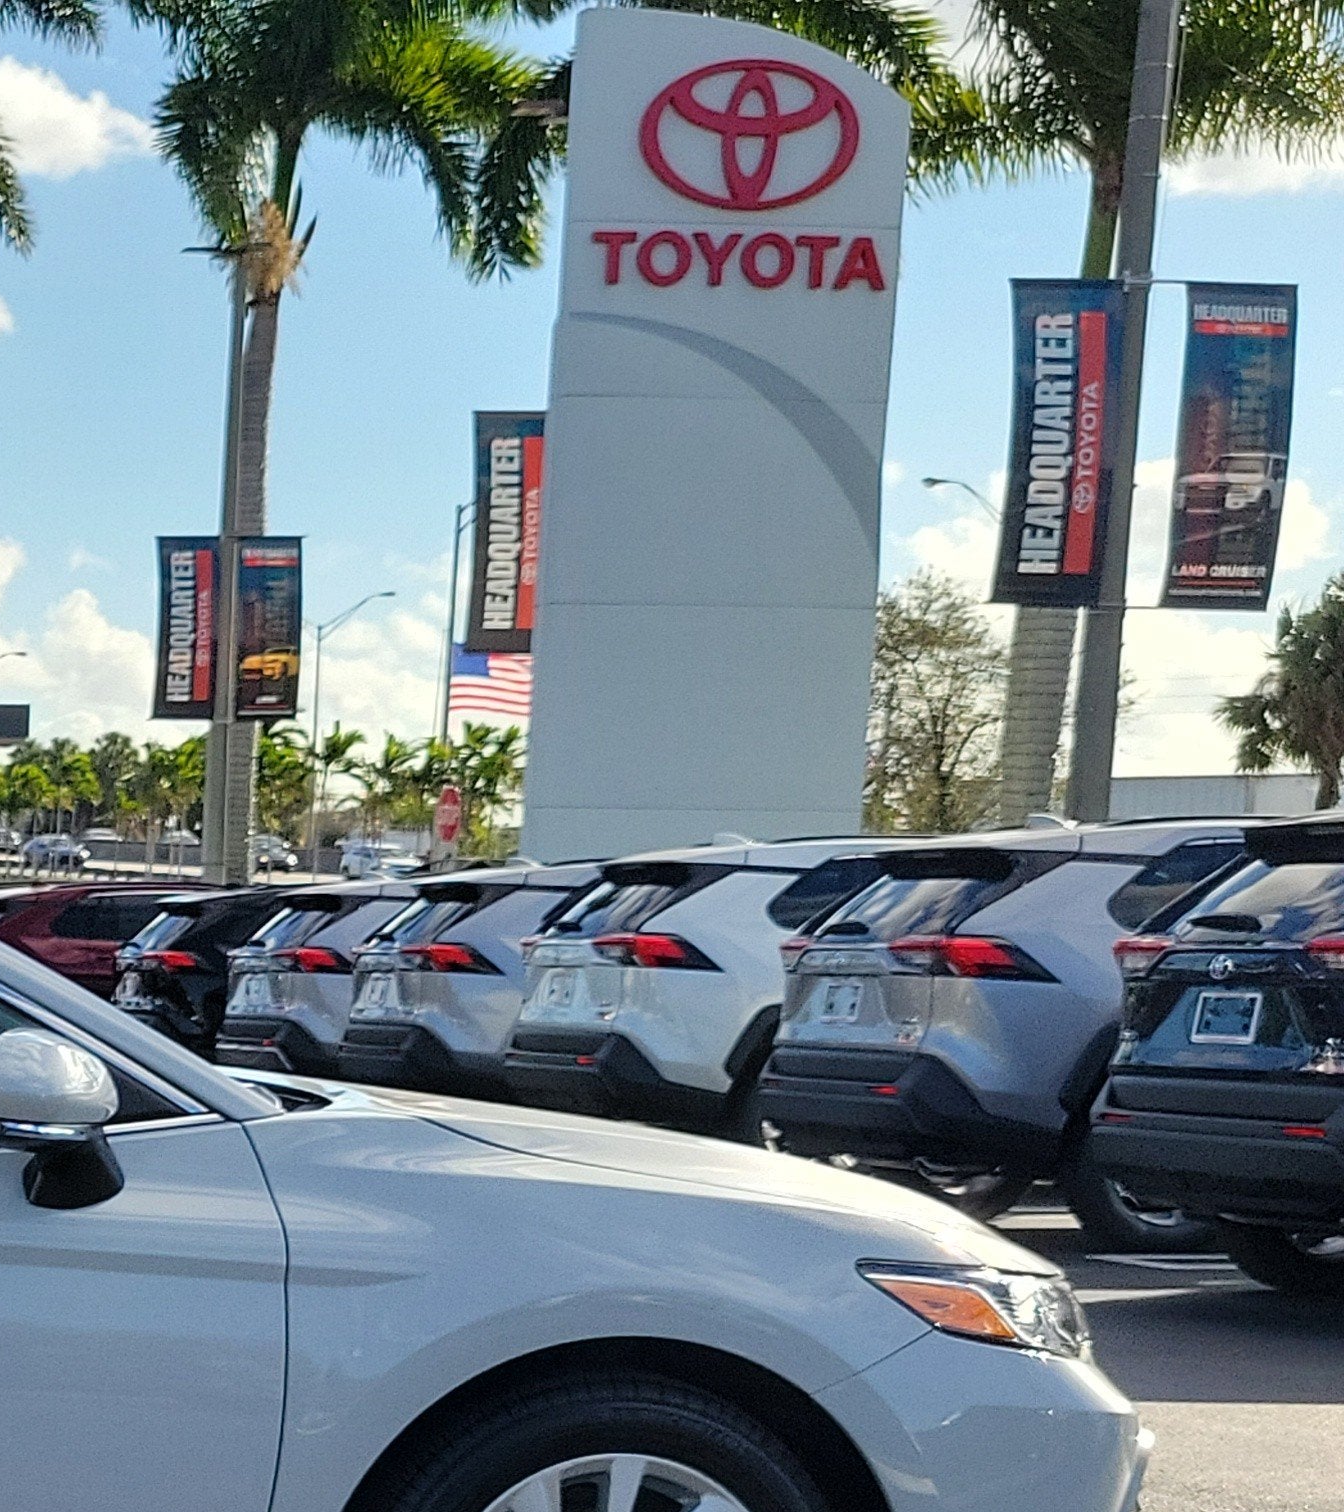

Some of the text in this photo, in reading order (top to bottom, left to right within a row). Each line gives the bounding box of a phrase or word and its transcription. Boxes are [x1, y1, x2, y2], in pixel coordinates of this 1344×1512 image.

[591, 230, 886, 292] TOYOTA
[1017, 312, 1074, 575] HEADQUARTER
[1076, 381, 1100, 480] TOYOTA
[482, 437, 522, 630] HEADQUARTER
[523, 488, 540, 564] TOYOTA
[1172, 564, 1207, 578] LAND
[166, 552, 196, 702] HEADQUARTER
